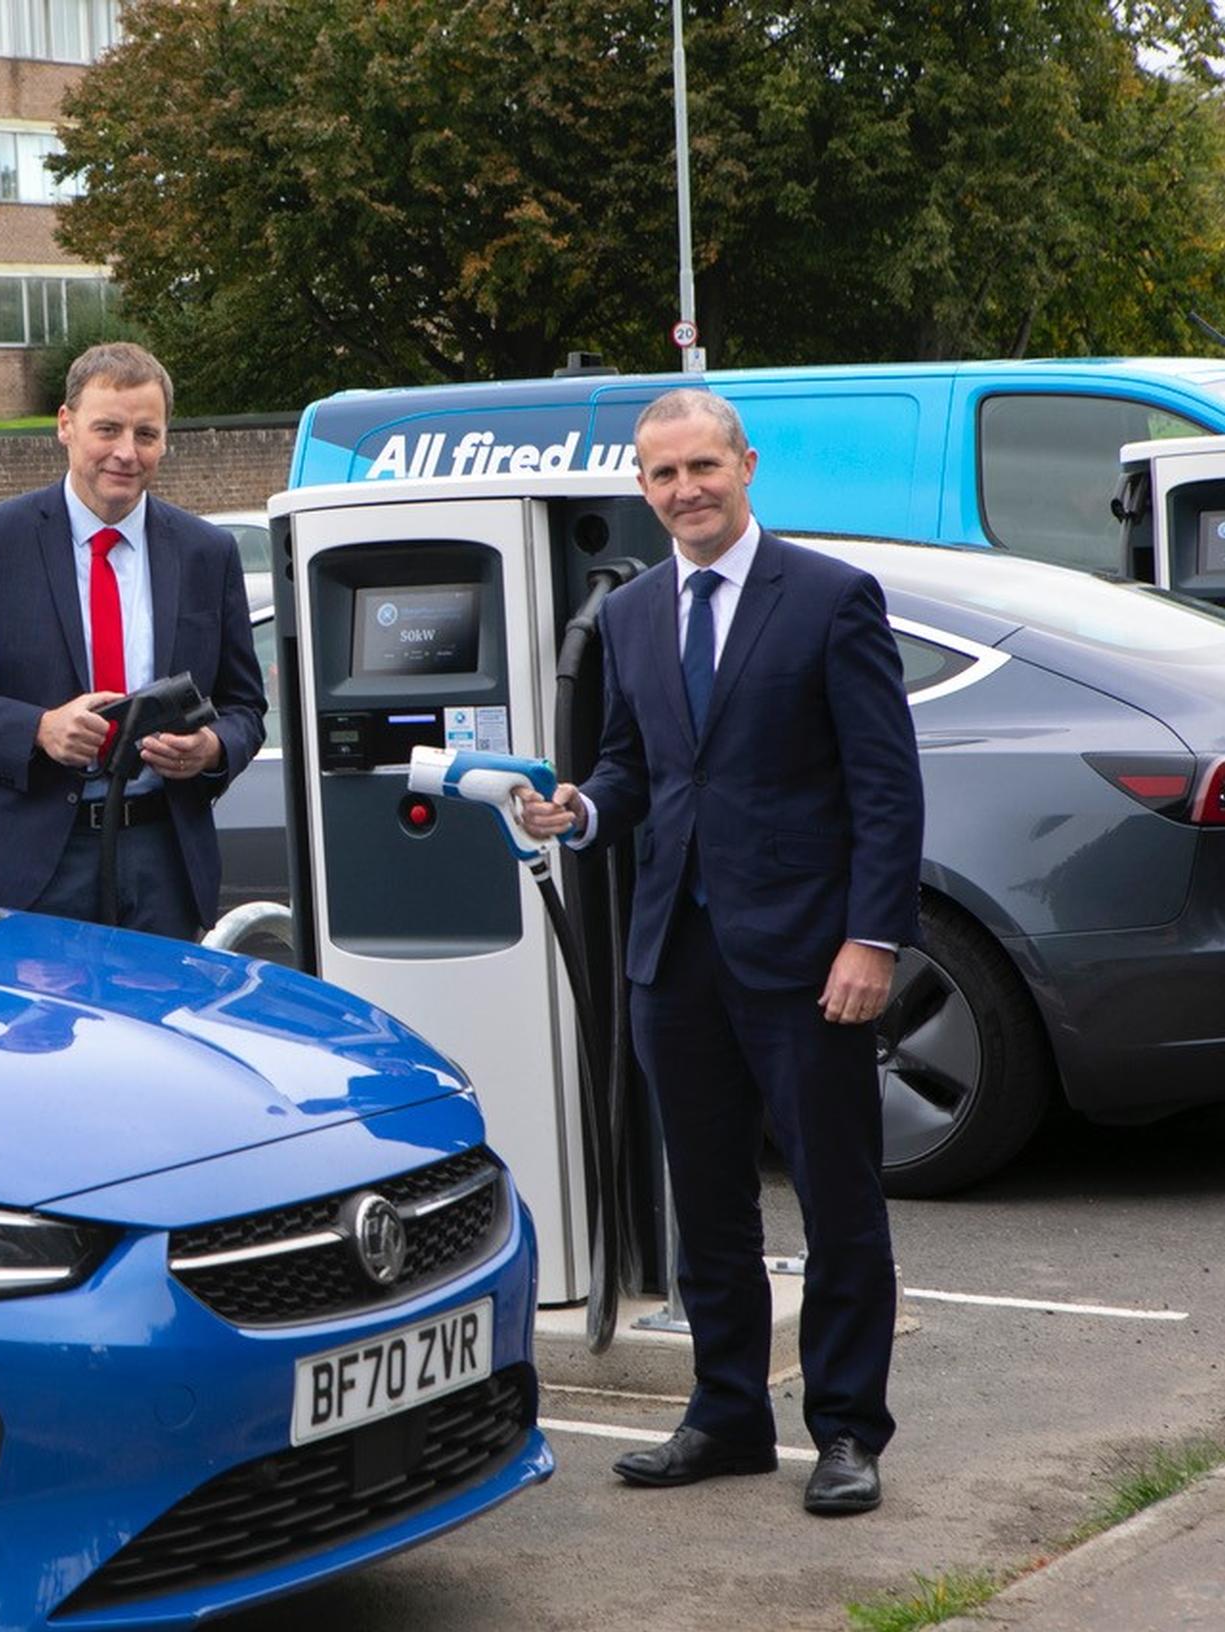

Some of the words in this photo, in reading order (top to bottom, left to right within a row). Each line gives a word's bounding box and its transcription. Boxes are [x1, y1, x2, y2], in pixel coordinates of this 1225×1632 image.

[676, 327, 695, 341] 20
[365, 433, 446, 479] All
[451, 431, 580, 477] fired
[311, 1339, 407, 1426] BF70
[417, 1313, 478, 1390] ZVR
